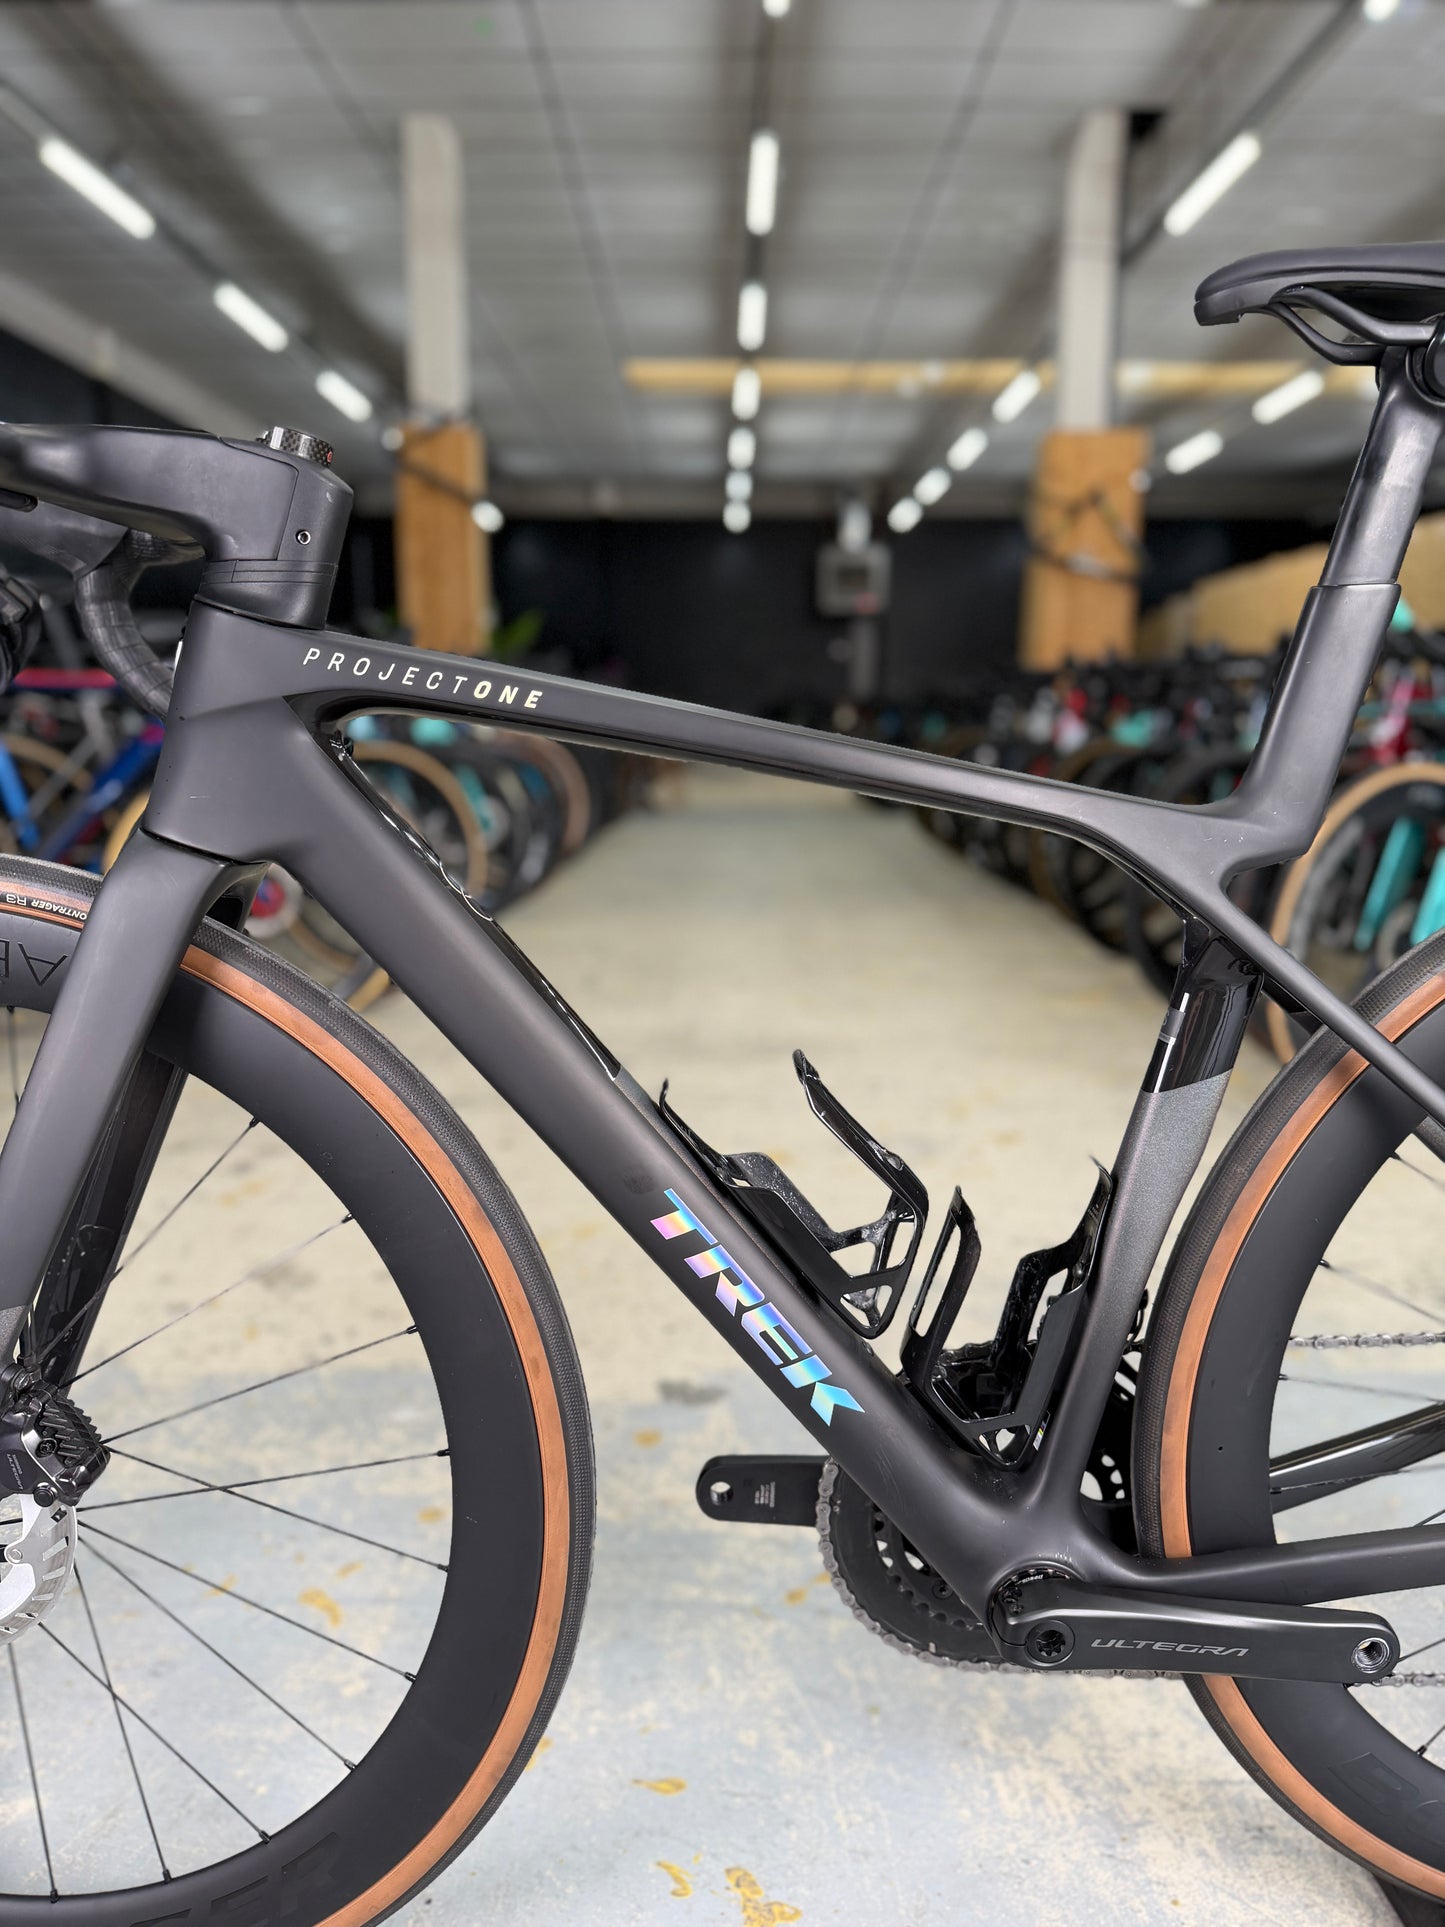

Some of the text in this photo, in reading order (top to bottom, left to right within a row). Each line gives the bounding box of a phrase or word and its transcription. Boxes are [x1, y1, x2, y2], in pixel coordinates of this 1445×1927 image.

[6, 893, 87, 920] ONTRAGER R3
[650, 1188, 865, 1427] TREK
[1091, 1638, 1249, 1657] ULTEGRA
